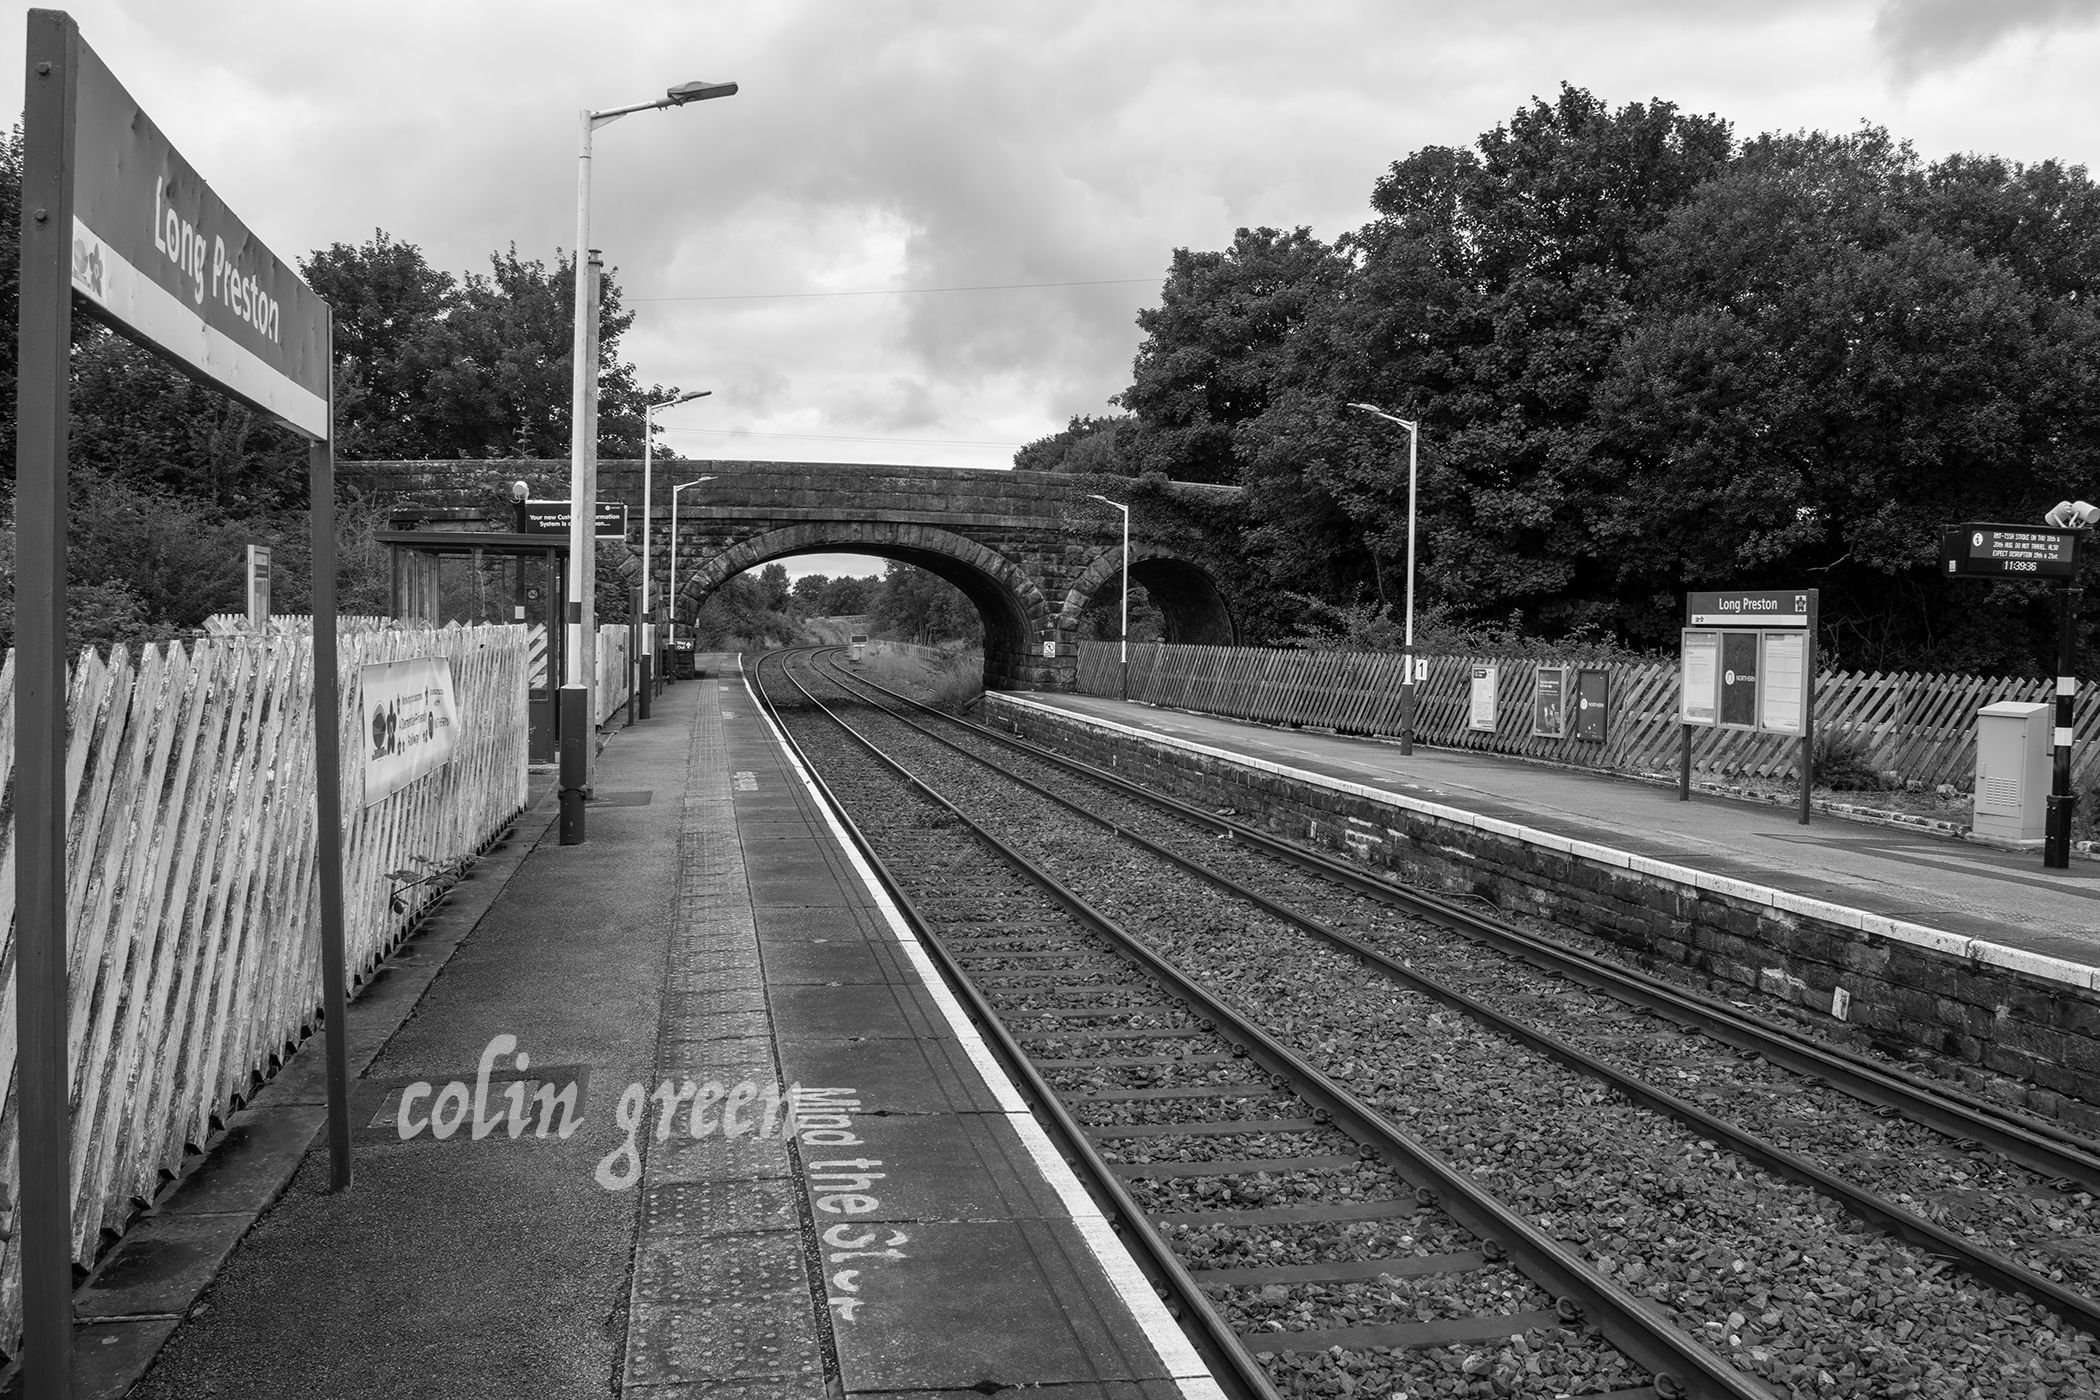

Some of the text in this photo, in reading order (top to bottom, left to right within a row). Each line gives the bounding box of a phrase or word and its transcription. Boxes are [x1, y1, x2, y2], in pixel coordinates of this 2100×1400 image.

[154, 175, 280, 345] Long Preston
[539, 520, 560, 528] System
[1992, 549, 2008, 557] EXPECT
[2009, 550, 2033, 558] DISRUPTION
[2004, 561, 2037, 571] 11:39:36
[1719, 598, 1778, 613] Long Preston
[1418, 662, 1424, 678] 1
[792, 1087, 864, 1145] Mind
[808, 1158, 886, 1215] the
